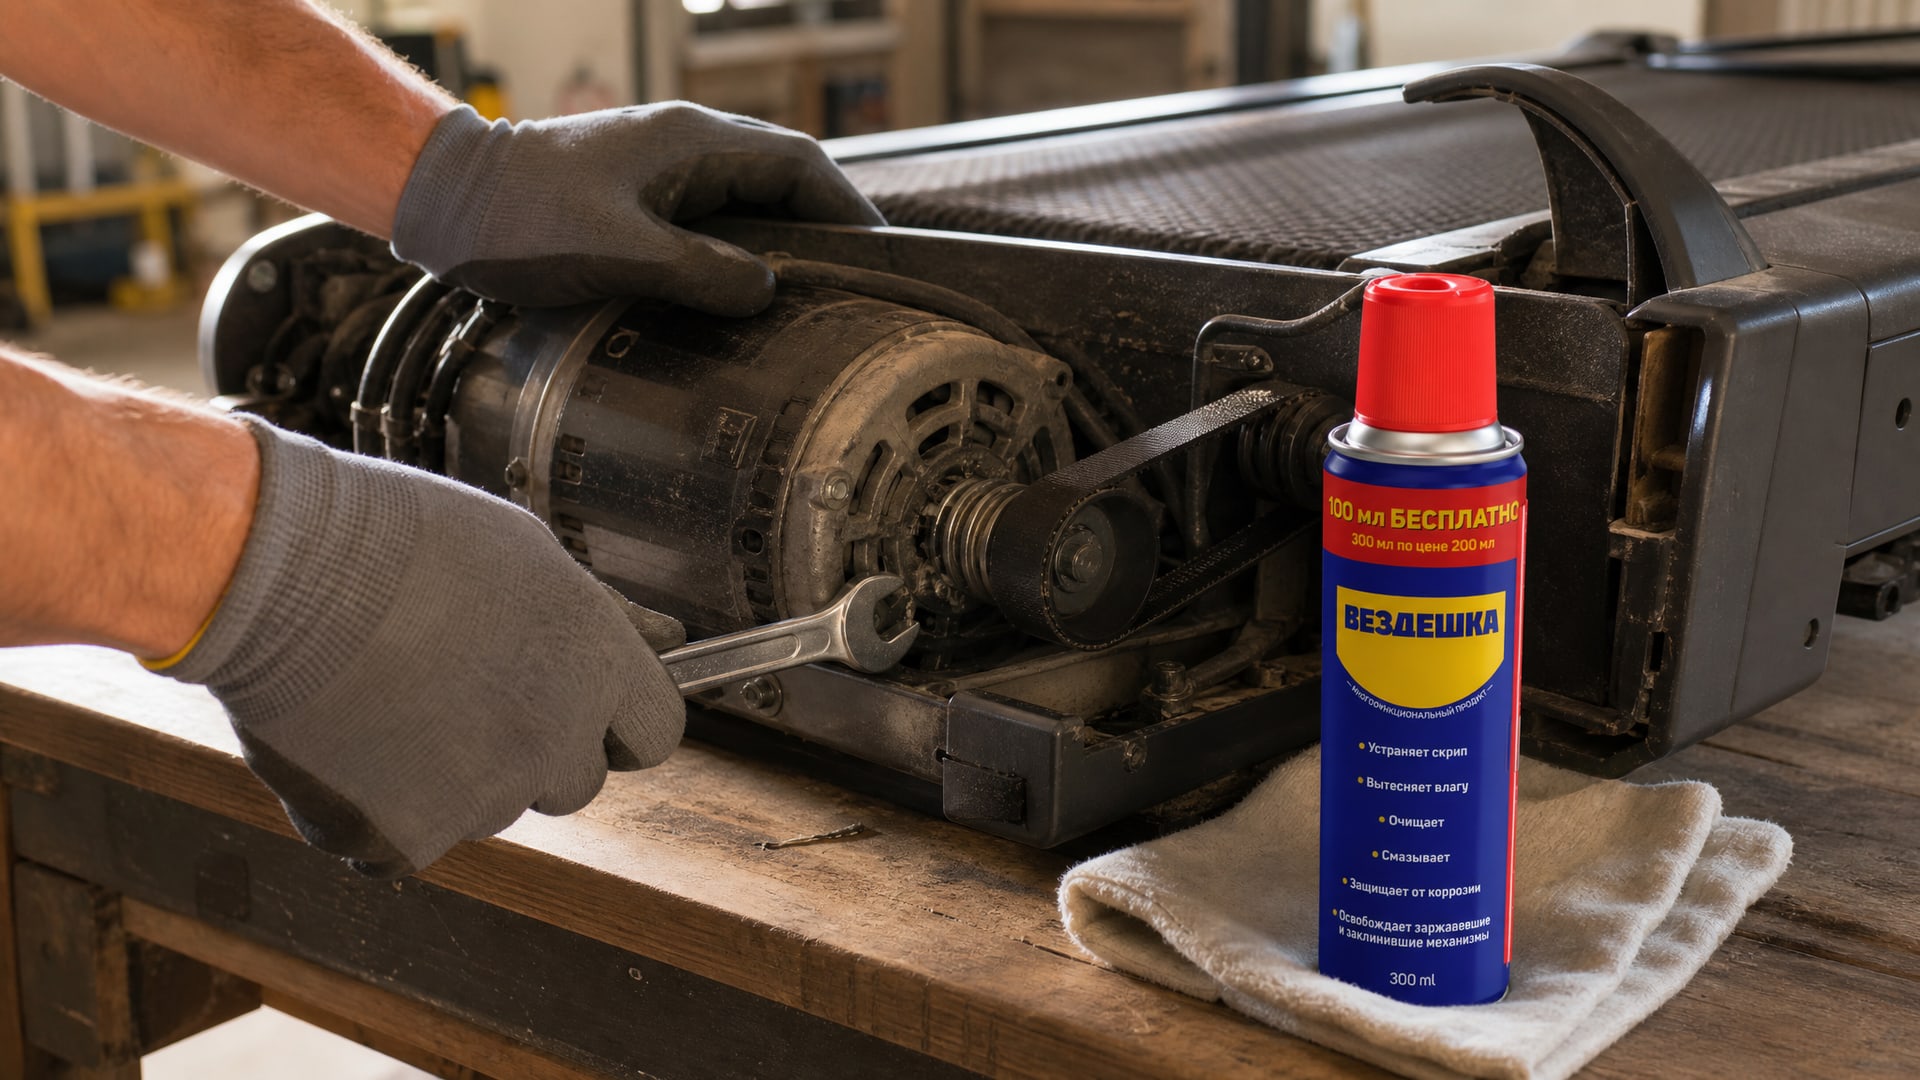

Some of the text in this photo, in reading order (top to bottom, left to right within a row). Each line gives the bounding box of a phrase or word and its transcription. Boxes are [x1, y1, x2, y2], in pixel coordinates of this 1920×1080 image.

[1328, 495, 1519, 530] 100 мл БЕСПЛАТНО
[1352, 533, 1495, 553] 300 мл по цене 200 мл
[1344, 604, 1499, 638] ВЕЗДЕШКА
[1368, 742, 1468, 760] Устраняет скрип
[1366, 776, 1469, 794] Вытесняет влагу
[1388, 815, 1445, 830] Очищает
[1381, 850, 1450, 863] Смазывает
[1349, 877, 1481, 899] Защищает от коррозии
[1338, 909, 1491, 936] Освобождает заржавевшие
[1338, 925, 1490, 949] и заклинившие механизмы
[1389, 972, 1436, 987] 300 ml
